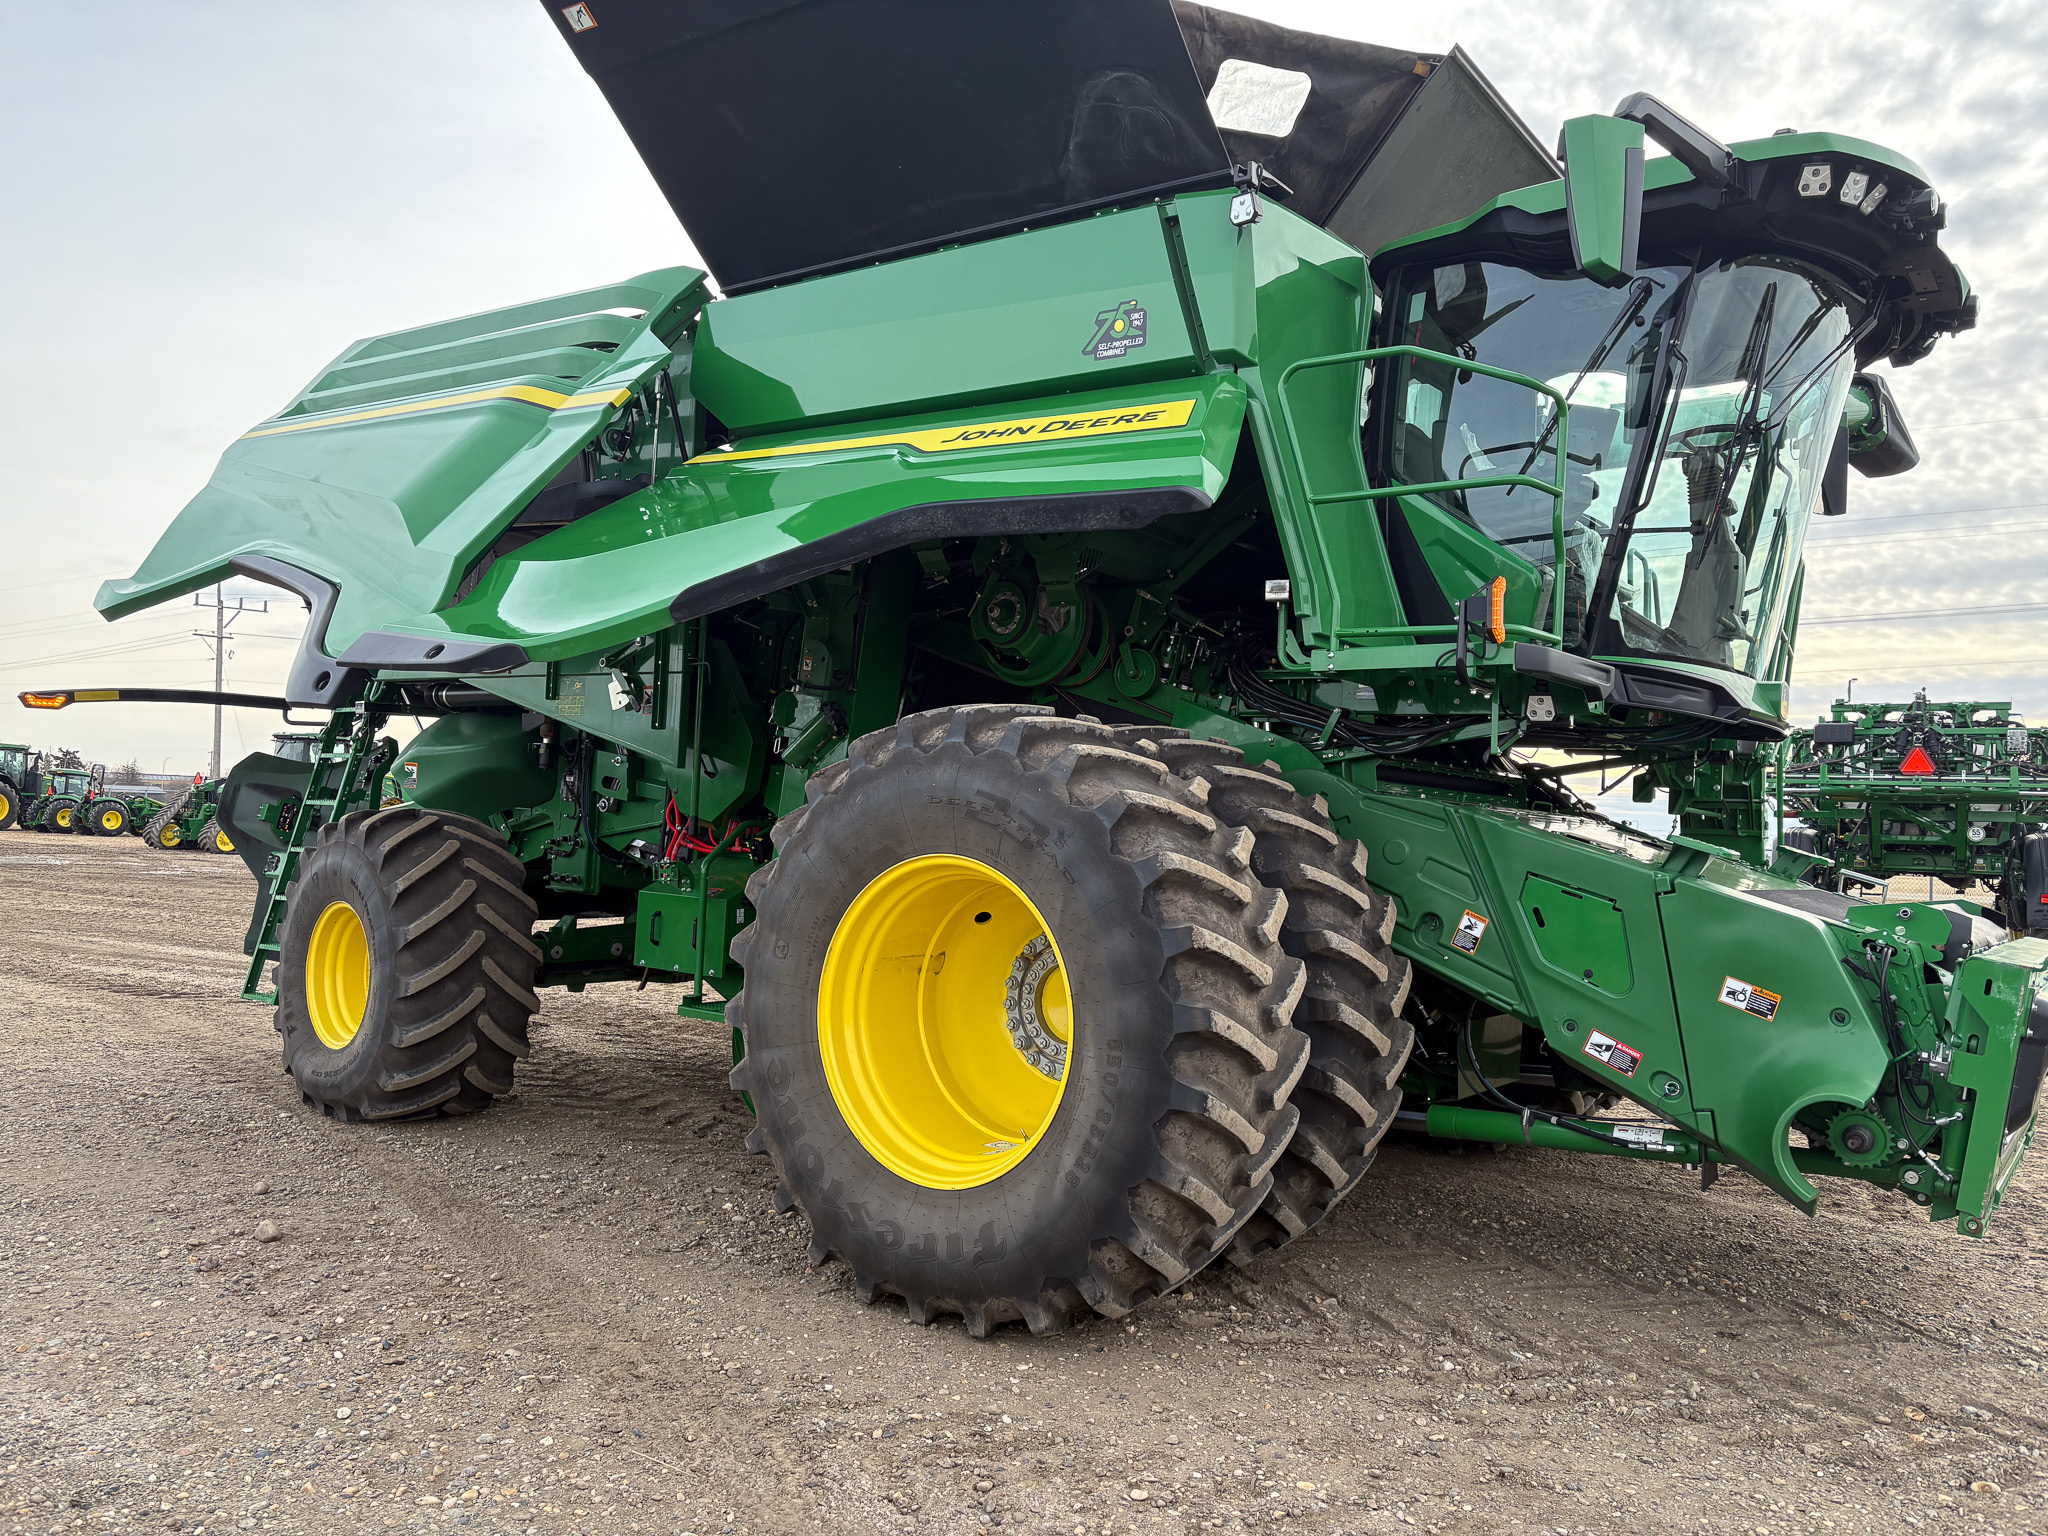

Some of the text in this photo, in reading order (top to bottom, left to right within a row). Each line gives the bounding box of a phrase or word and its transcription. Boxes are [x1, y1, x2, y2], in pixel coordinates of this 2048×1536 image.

[1130, 311, 1144, 320] SINCE
[1085, 302, 1137, 351] 75
[1132, 319, 1143, 327] 1947
[1097, 337, 1143, 350] SELF-PROPELLED
[1096, 347, 1125, 357] COMBINES
[940, 410, 1167, 443] JOHN DEERE
[1622, 1045, 1641, 1058] DANGER
[1064, 1038, 1123, 1188] 650/85R38
[766, 1056, 1008, 1270] Firestone
